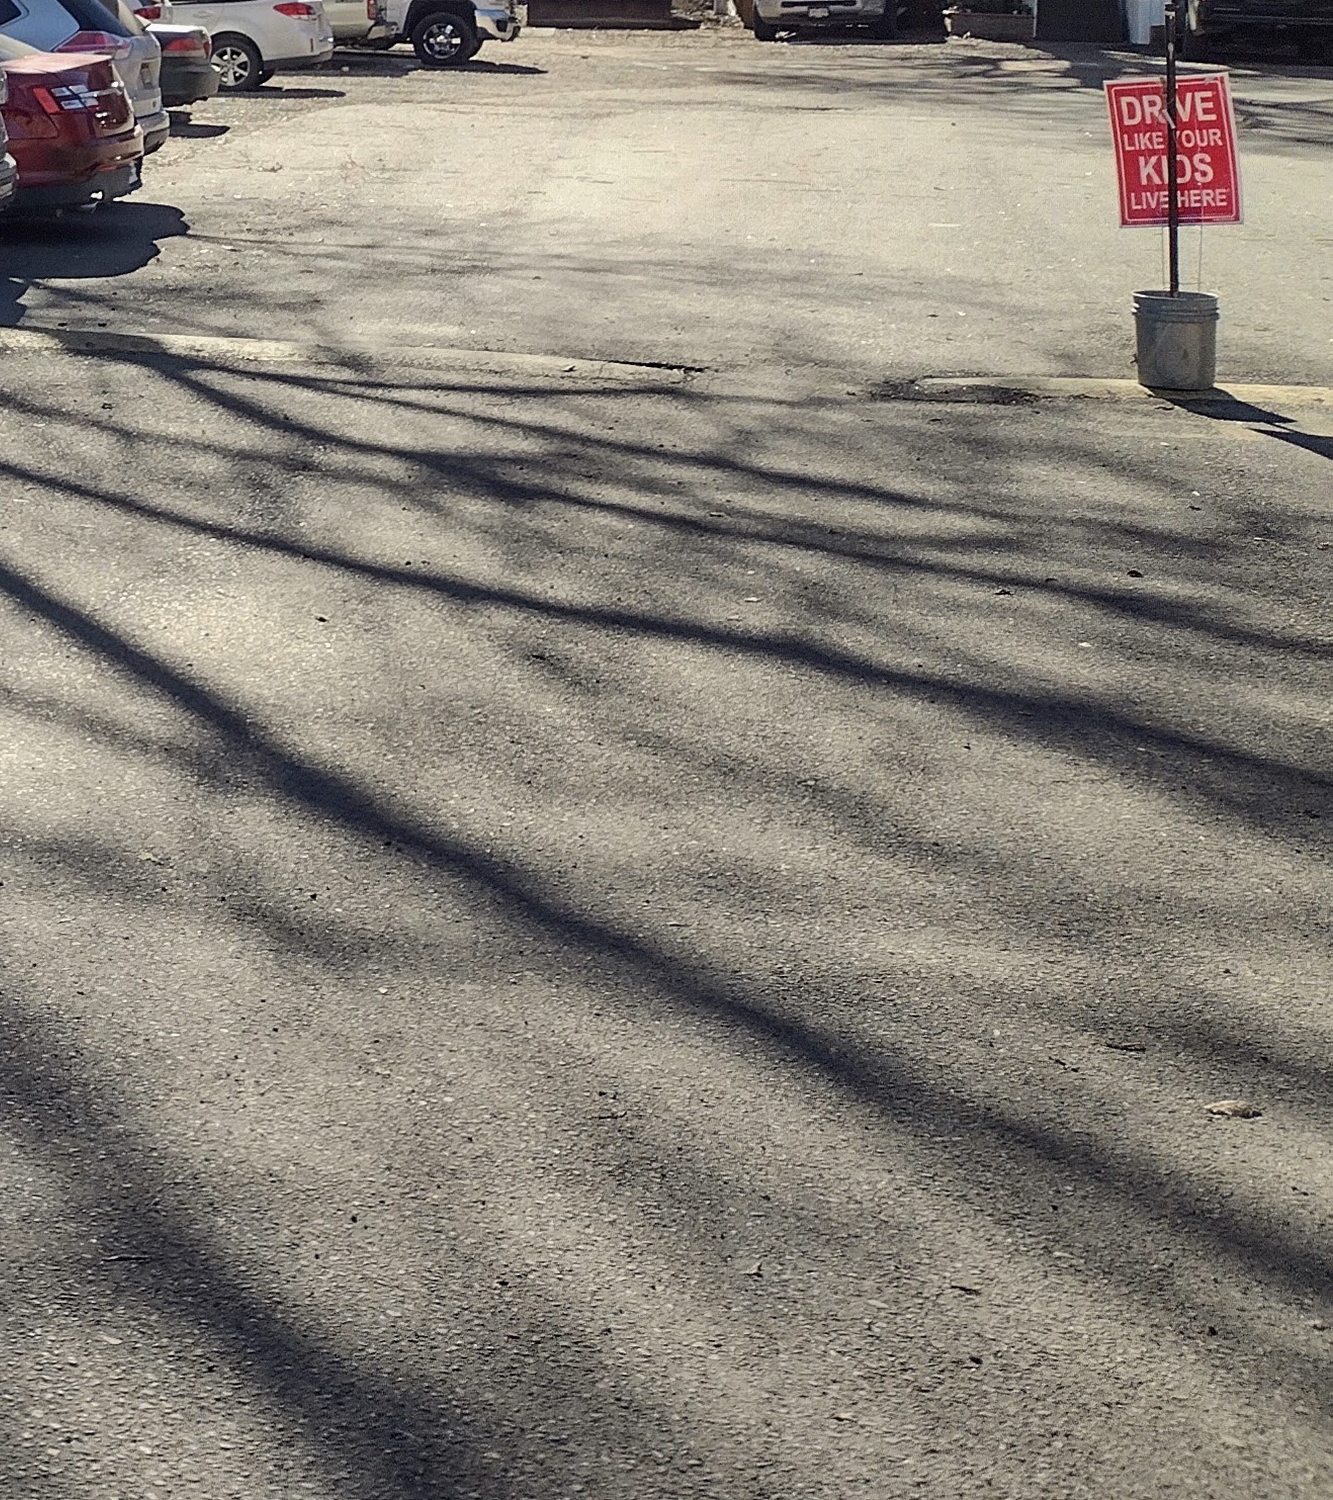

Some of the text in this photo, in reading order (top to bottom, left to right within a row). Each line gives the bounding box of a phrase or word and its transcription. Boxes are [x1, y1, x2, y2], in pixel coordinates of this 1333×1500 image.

[1120, 91, 1217, 125] DRVE
[1123, 129, 1222, 151] LIKE OUR
[1131, 189, 1227, 210] LIVE HERE
